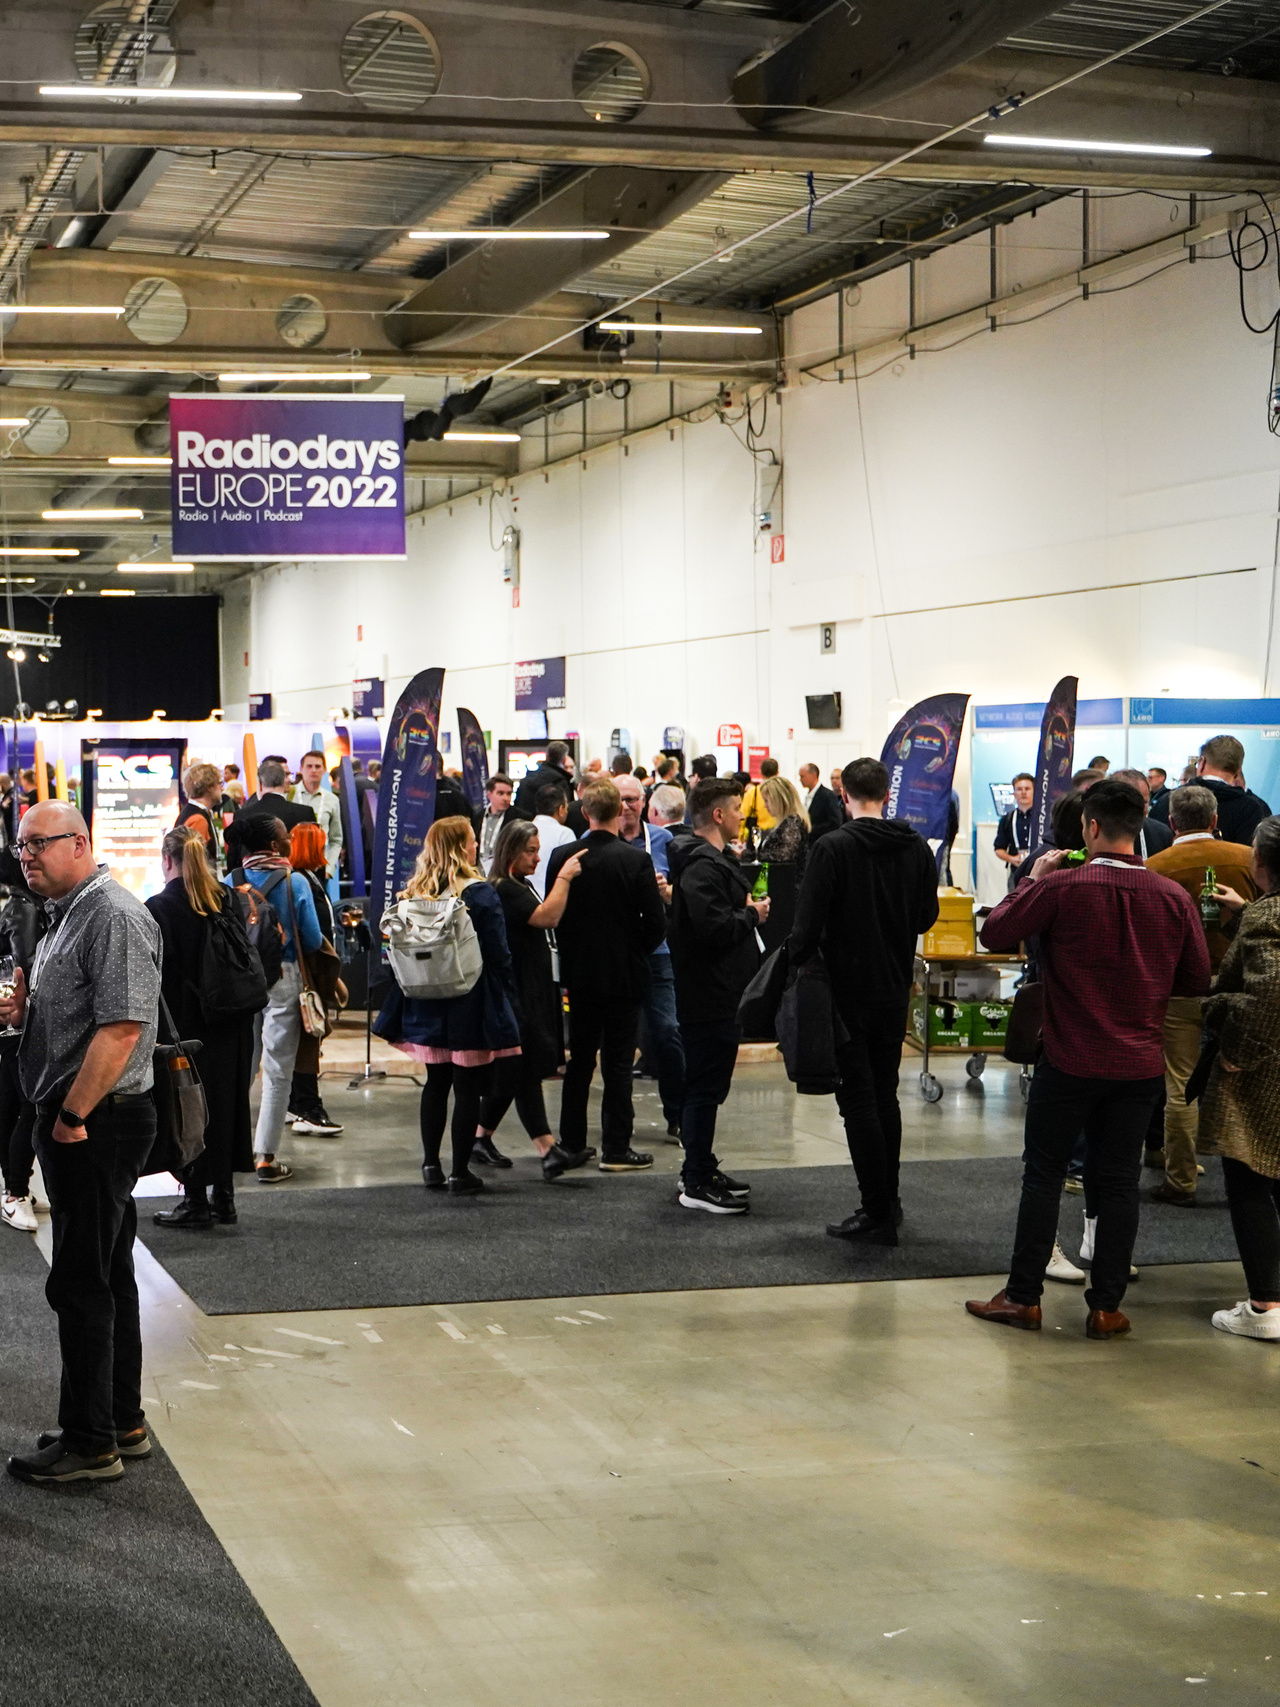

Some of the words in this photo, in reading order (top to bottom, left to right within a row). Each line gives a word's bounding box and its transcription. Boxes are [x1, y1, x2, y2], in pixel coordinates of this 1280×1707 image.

[178, 431, 401, 475] Radiodays
[178, 474, 303, 508] EUROPE
[306, 475, 398, 508] 2022
[179, 510, 209, 522] Radio
[221, 510, 252, 522] Audio
[264, 510, 303, 522] Podcast
[824, 627, 833, 649] B
[97, 755, 174, 781] RCS
[886, 765, 904, 820] GRATION
[385, 769, 402, 875] INTEGRATION
[384, 880, 394, 913] RUE
